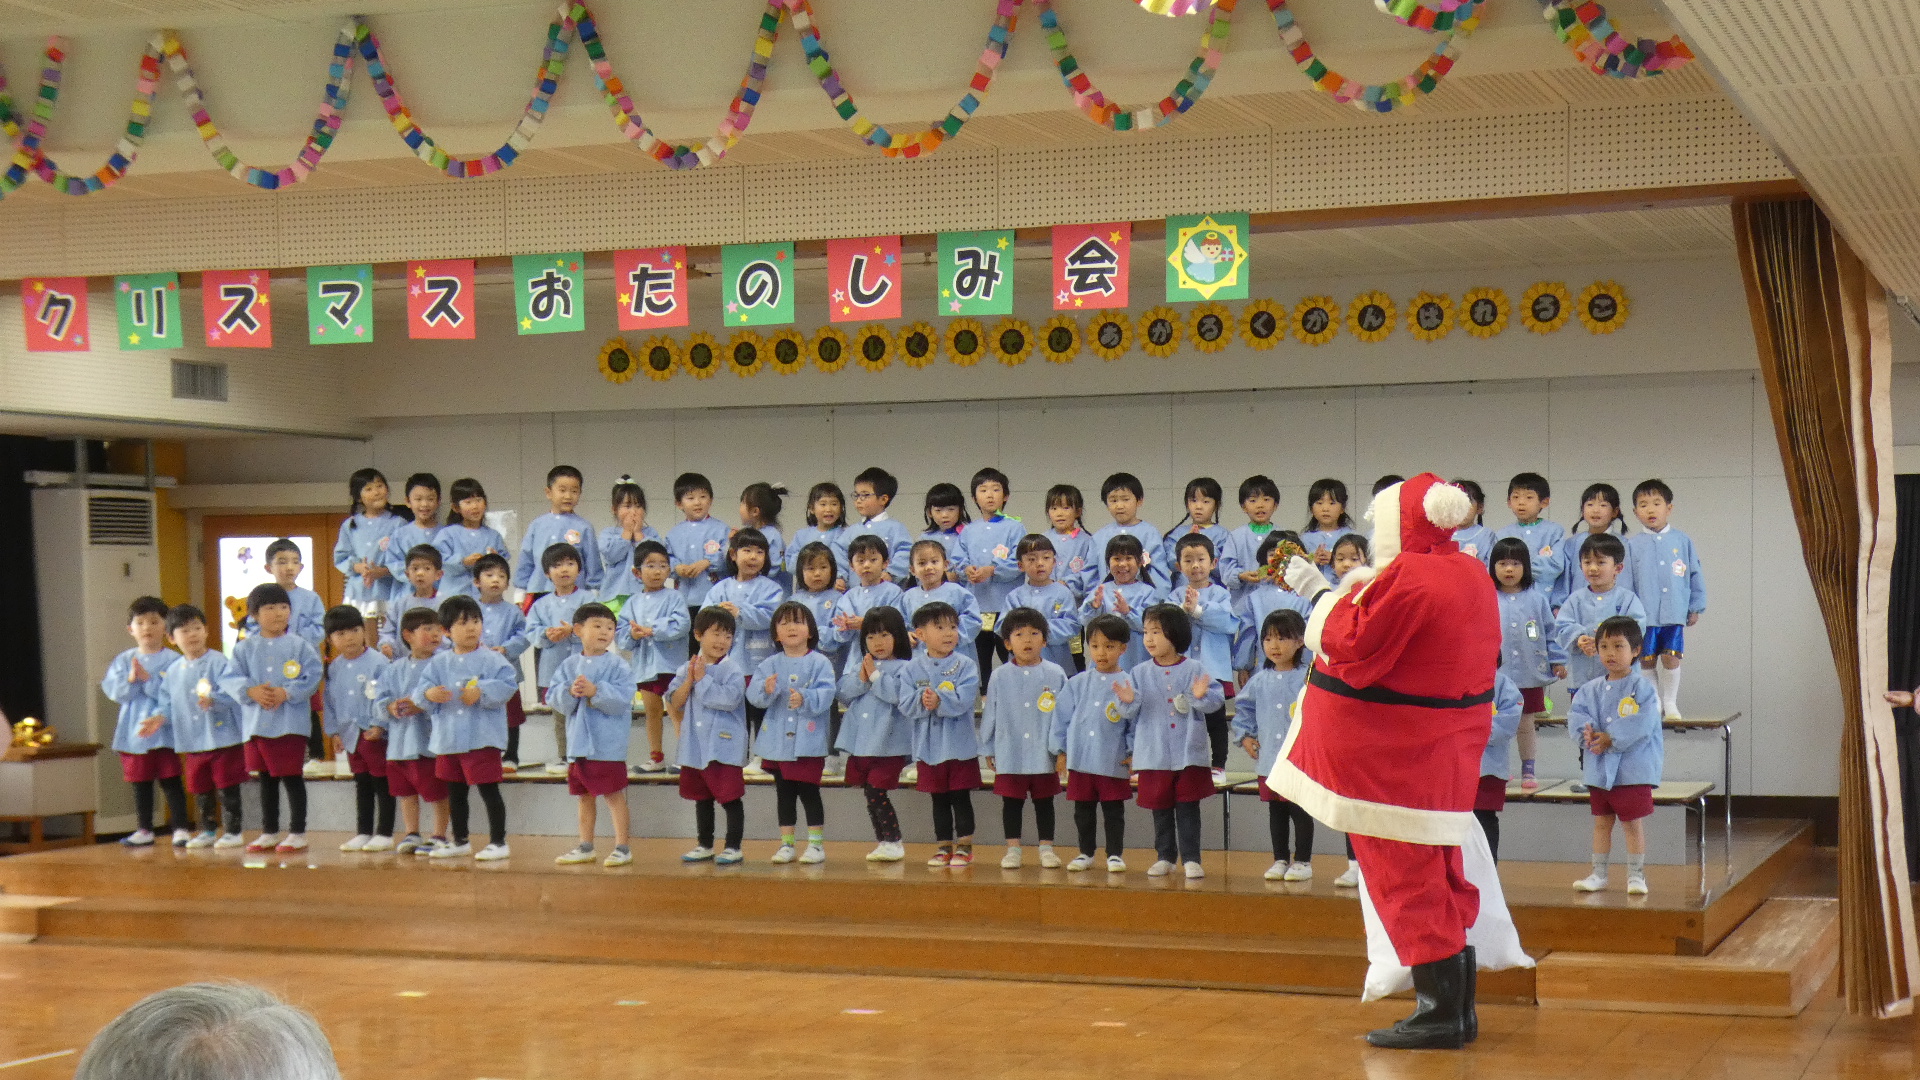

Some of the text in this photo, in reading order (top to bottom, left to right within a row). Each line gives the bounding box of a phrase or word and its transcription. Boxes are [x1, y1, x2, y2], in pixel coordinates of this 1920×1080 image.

[35, 235, 1118, 341] クリスマスおたのしみ会
